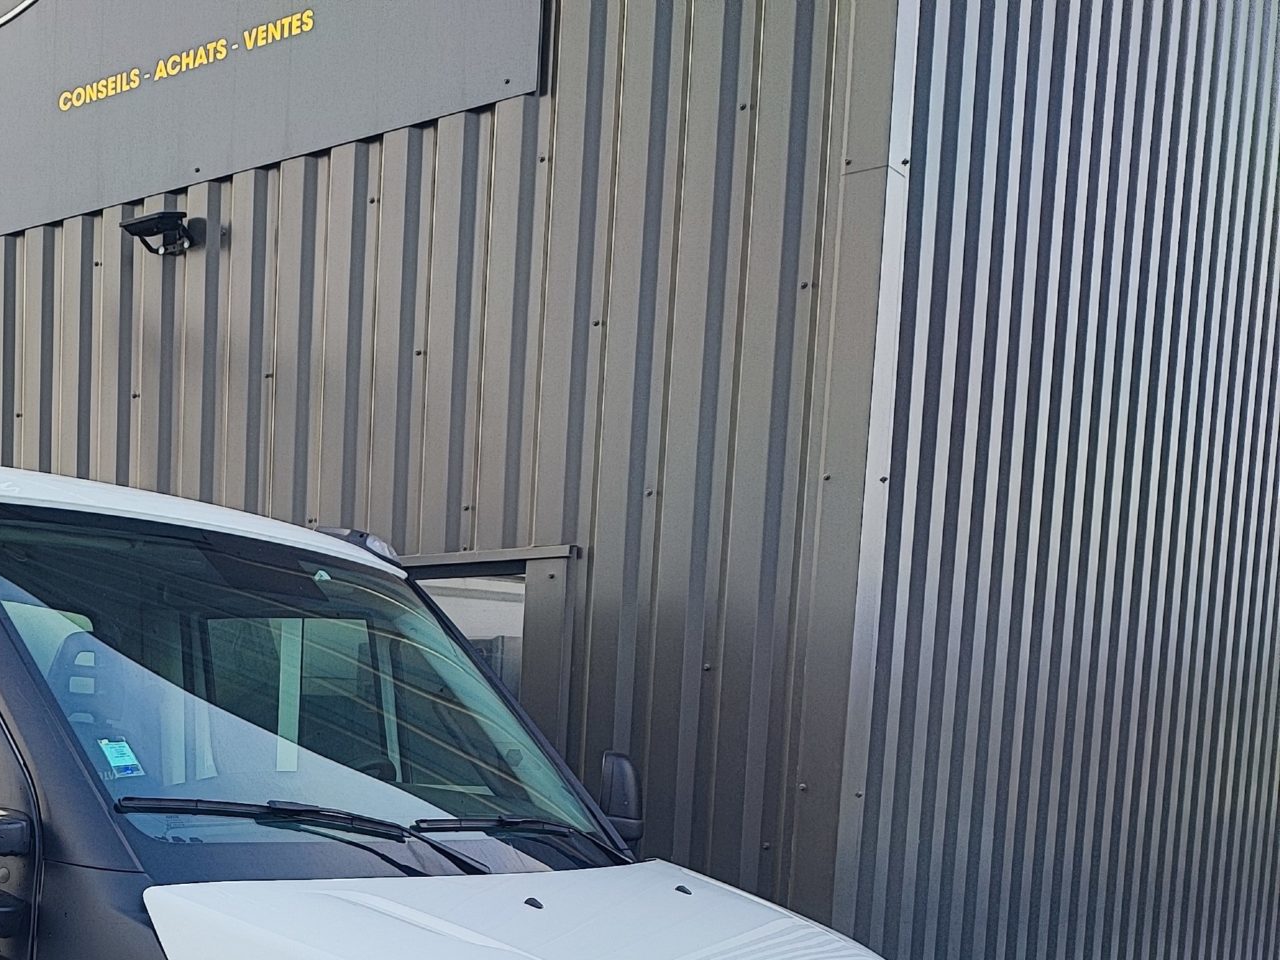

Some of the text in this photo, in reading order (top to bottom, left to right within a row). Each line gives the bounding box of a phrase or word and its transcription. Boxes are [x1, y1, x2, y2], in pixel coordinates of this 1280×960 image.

[58, 68, 140, 112] CONSEILS
[153, 38, 228, 82] ACHATS
[243, 9, 315, 52] VENTES
